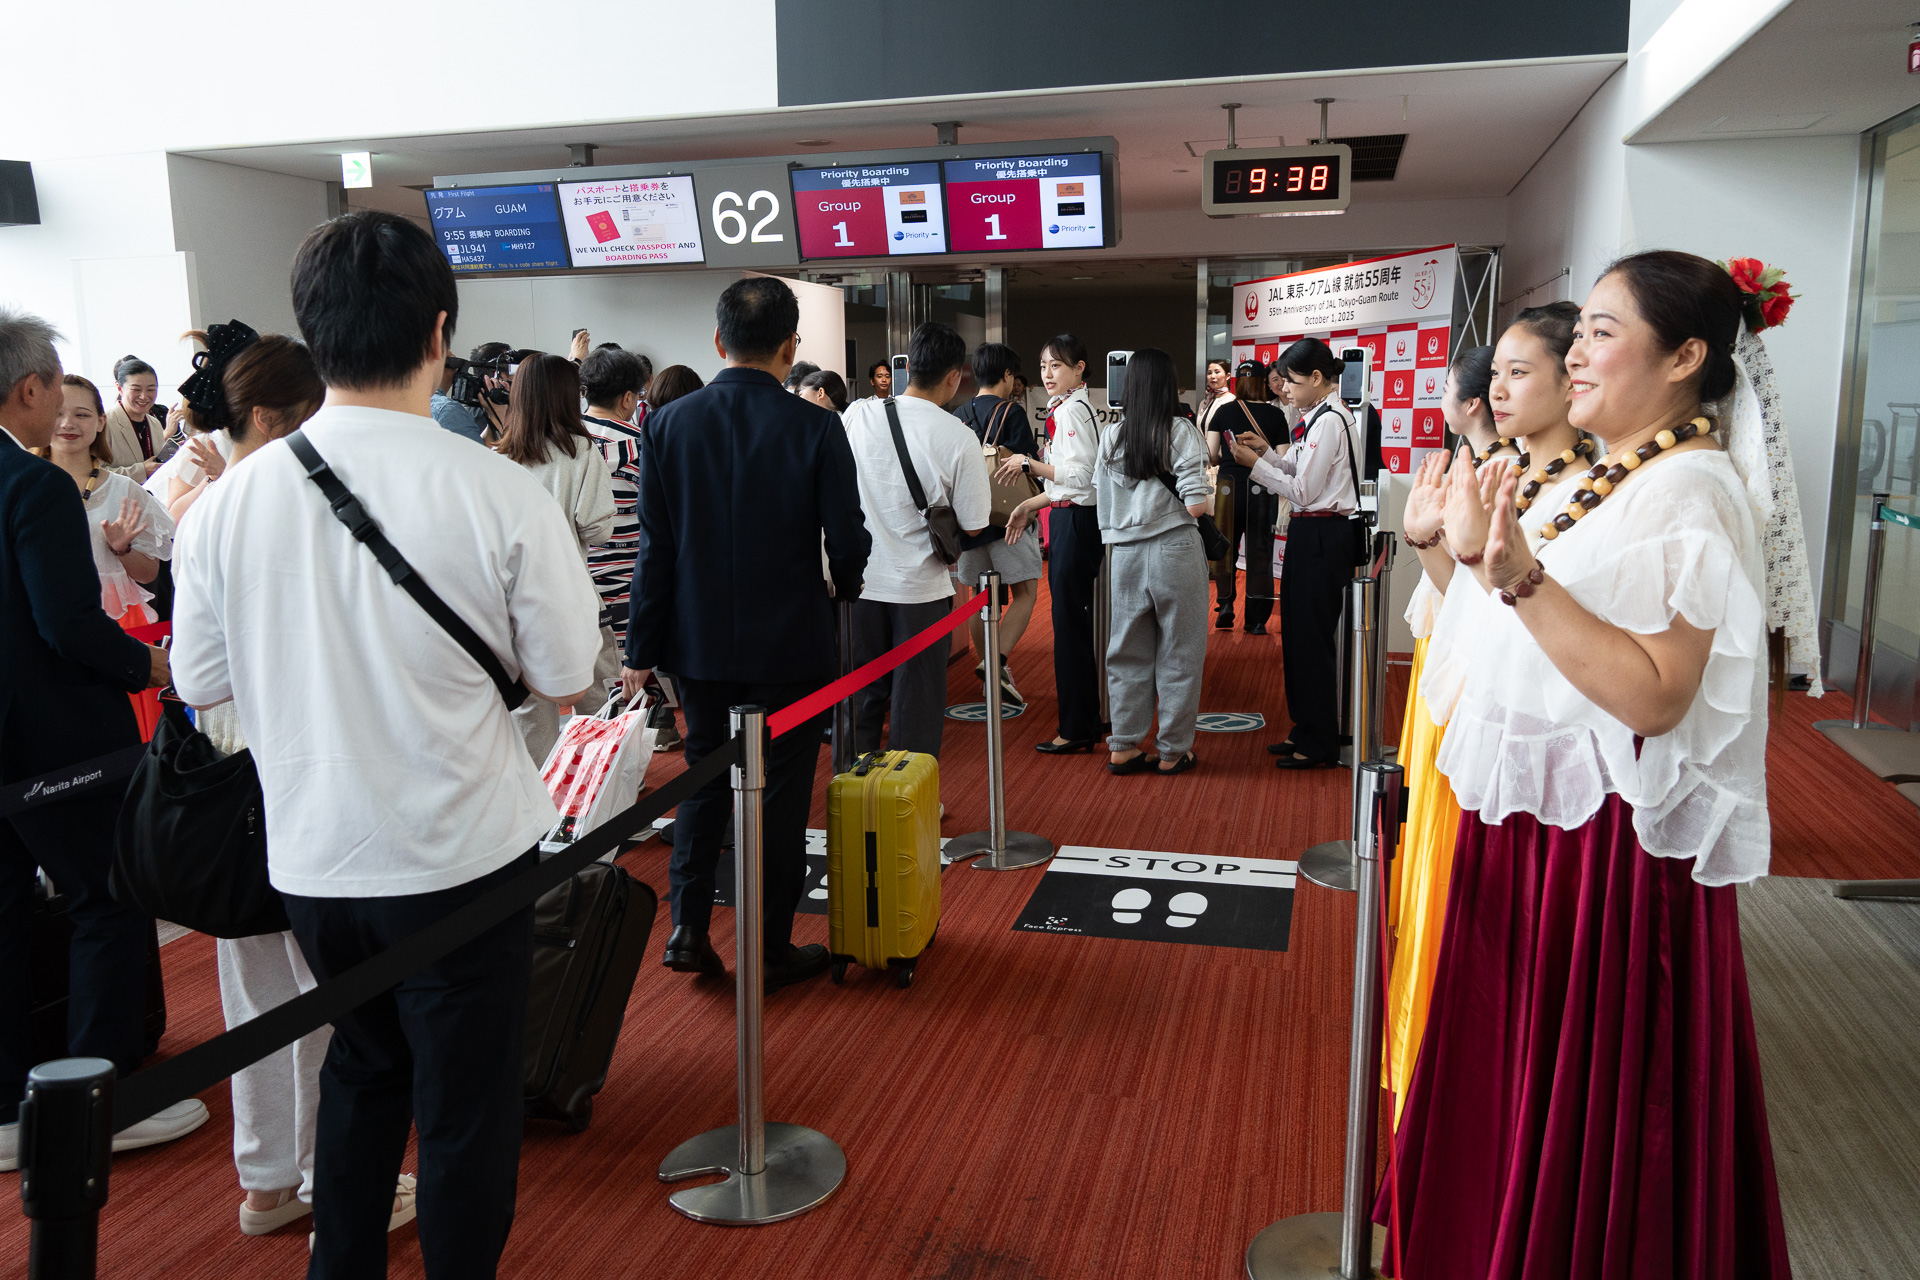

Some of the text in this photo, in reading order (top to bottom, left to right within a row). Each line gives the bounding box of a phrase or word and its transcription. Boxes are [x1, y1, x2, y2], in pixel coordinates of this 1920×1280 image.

[975, 158, 1068, 170] Priority Boarding
[820, 166, 910, 179] Priority Boarding
[996, 168, 1048, 179] 優先搭乗中
[841, 177, 890, 188] 優先搭乗中
[1249, 165, 1329, 194] 9:38
[576, 182, 669, 194] パスポートと搭乗券を
[573, 192, 675, 206] お手元にご用意ください
[970, 192, 1016, 205] Group
[434, 203, 527, 219] グアム GUAM
[818, 201, 862, 213] Group
[711, 189, 784, 245] 62
[984, 213, 1007, 241] 1
[1060, 225, 1087, 233] Priority
[444, 231, 466, 241] 9:55
[494, 228, 531, 238] BOARDING
[832, 221, 855, 247] 1
[905, 231, 930, 240] Priority
[460, 244, 487, 254] JL941
[636, 243, 676, 251] PASSPORT
[605, 252, 668, 261] BOARDING PASS
[1268, 287, 1284, 302] JAL
[1343, 265, 1402, 291] 就航55周年
[1268, 291, 1399, 316] 55th Anniversary of JAL Tokyo-Guam Route
[1304, 315, 1330, 326] October
[1338, 311, 1355, 322] 2025
[42, 769, 102, 796] Narita Airport
[1104, 855, 1241, 876] STOP
